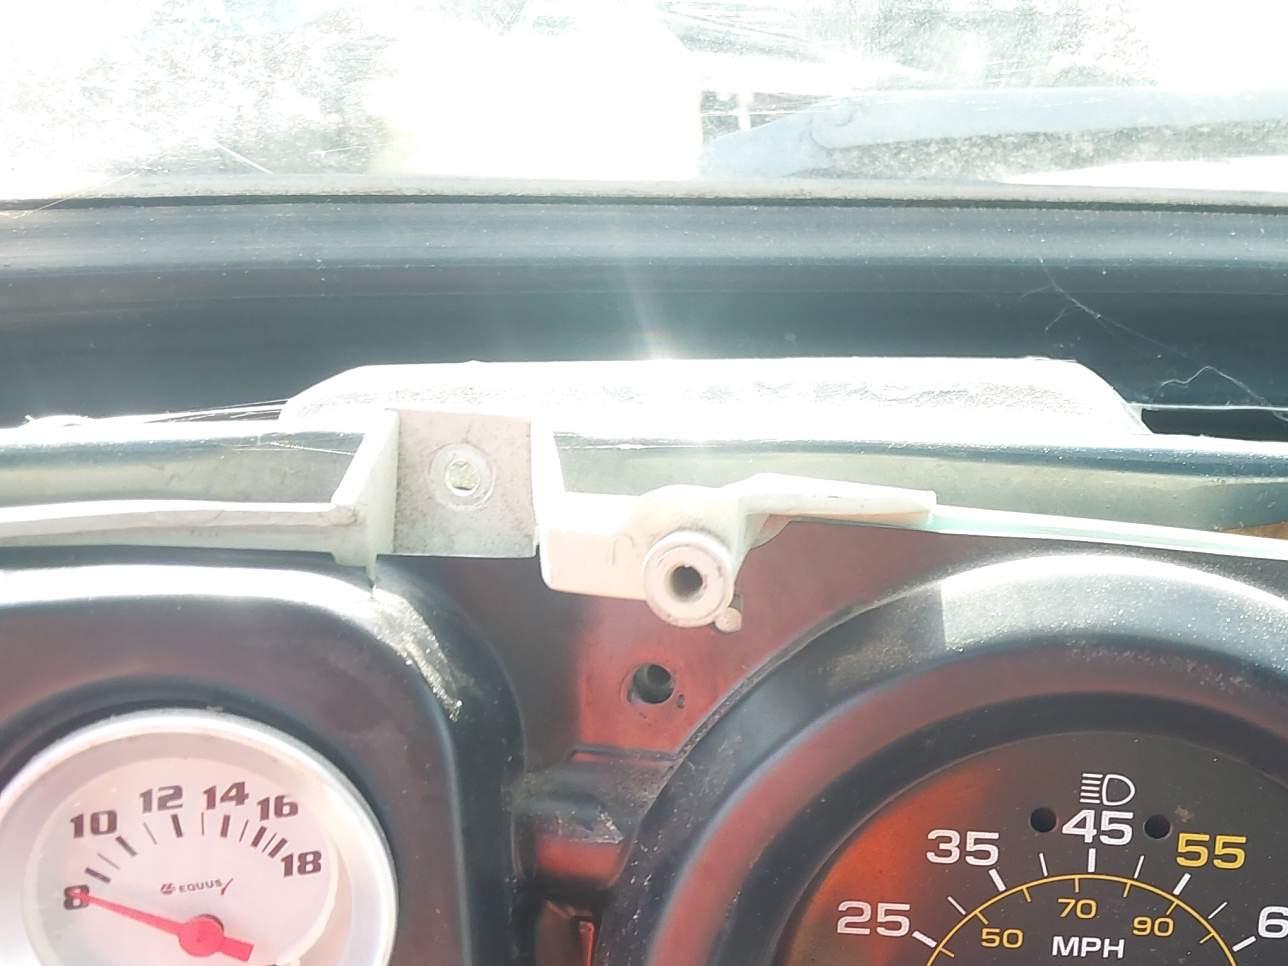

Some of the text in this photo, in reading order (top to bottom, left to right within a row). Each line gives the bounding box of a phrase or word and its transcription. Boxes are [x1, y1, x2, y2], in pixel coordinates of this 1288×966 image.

[139, 785, 183, 813] 12
[202, 782, 249, 810] 14
[257, 795, 299, 821] 16
[70, 810, 117, 839] 10
[1062, 809, 1134, 845] 45
[926, 831, 1000, 865] 35
[1176, 833, 1247, 869] 55
[282, 850, 322, 878] 18
[179, 879, 224, 893] EQUUS
[836, 902, 911, 936] 25
[1057, 899, 1097, 919] 70
[980, 928, 1023, 949] 50
[1132, 917, 1175, 938] 90
[1052, 937, 1124, 958] MPH
